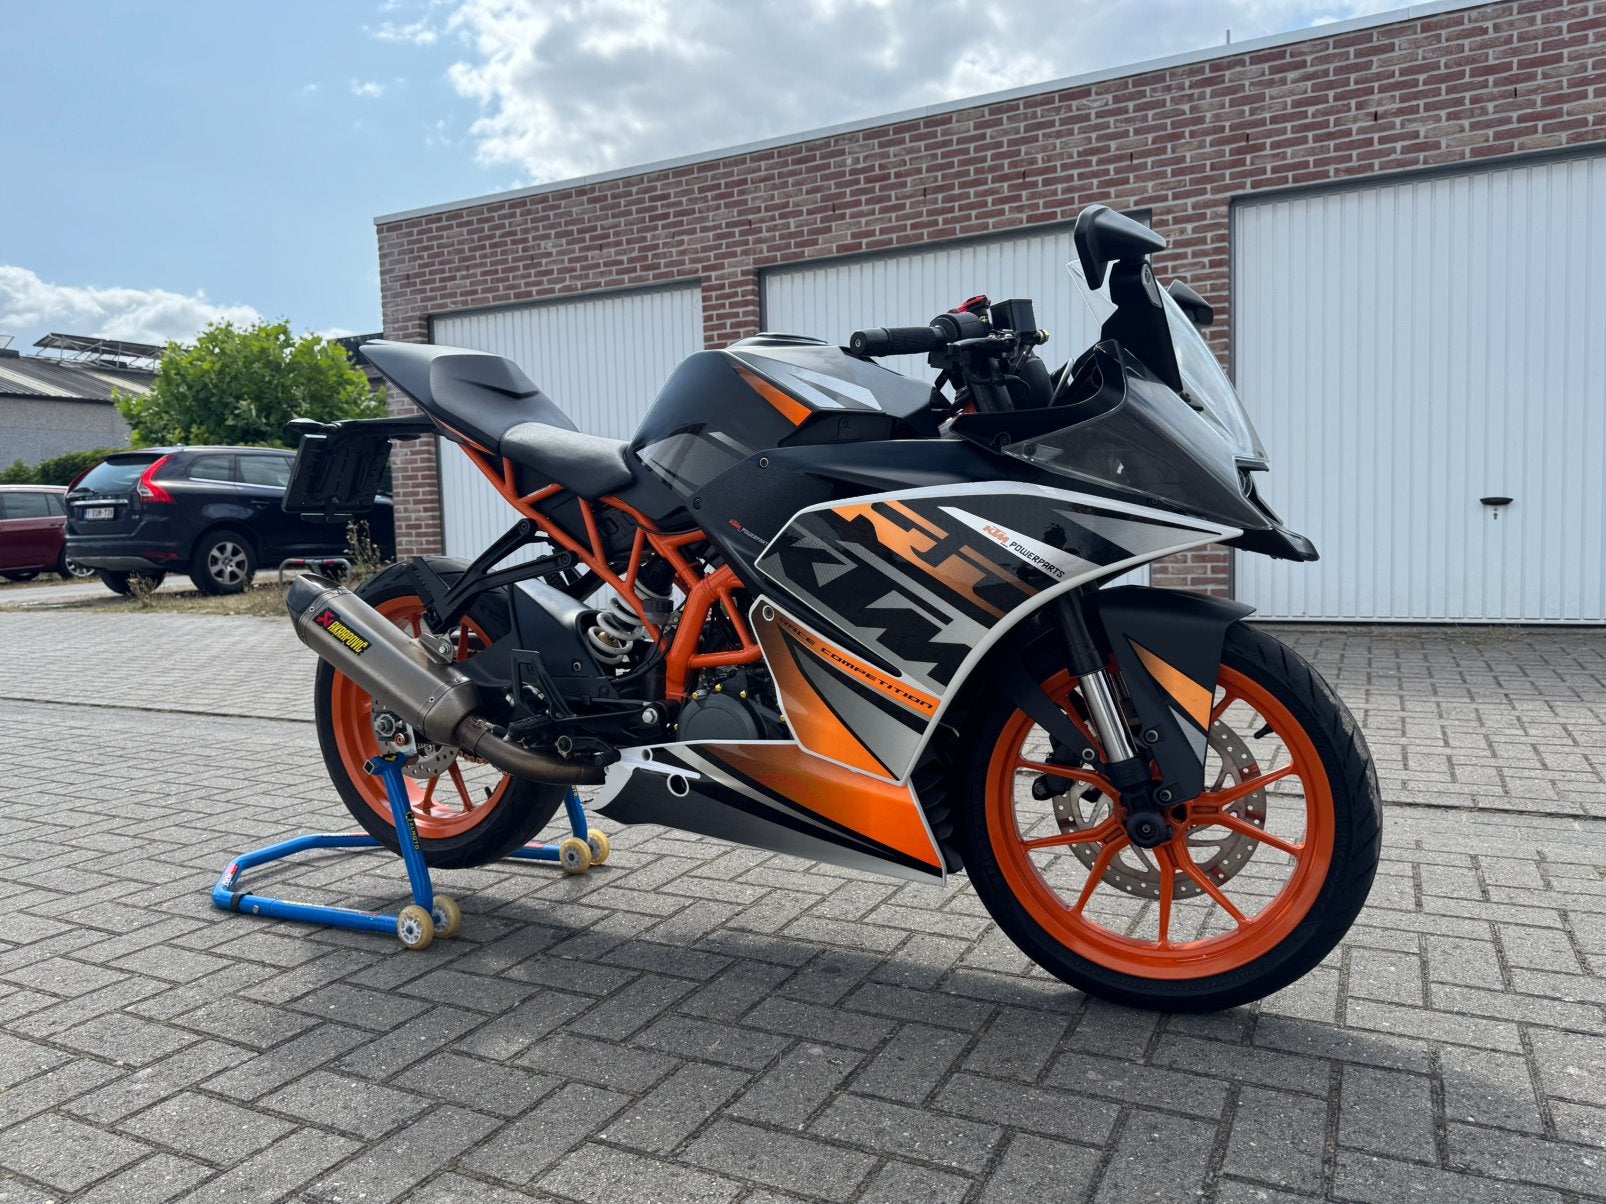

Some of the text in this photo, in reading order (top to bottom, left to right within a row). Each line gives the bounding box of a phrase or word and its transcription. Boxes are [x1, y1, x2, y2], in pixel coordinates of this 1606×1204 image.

[729, 519, 769, 546] KTM POWERPART
[982, 525, 1066, 578] KTM POWERPARTS
[759, 526, 973, 690] KTM
[780, 617, 934, 710] RACE COMPETITION
